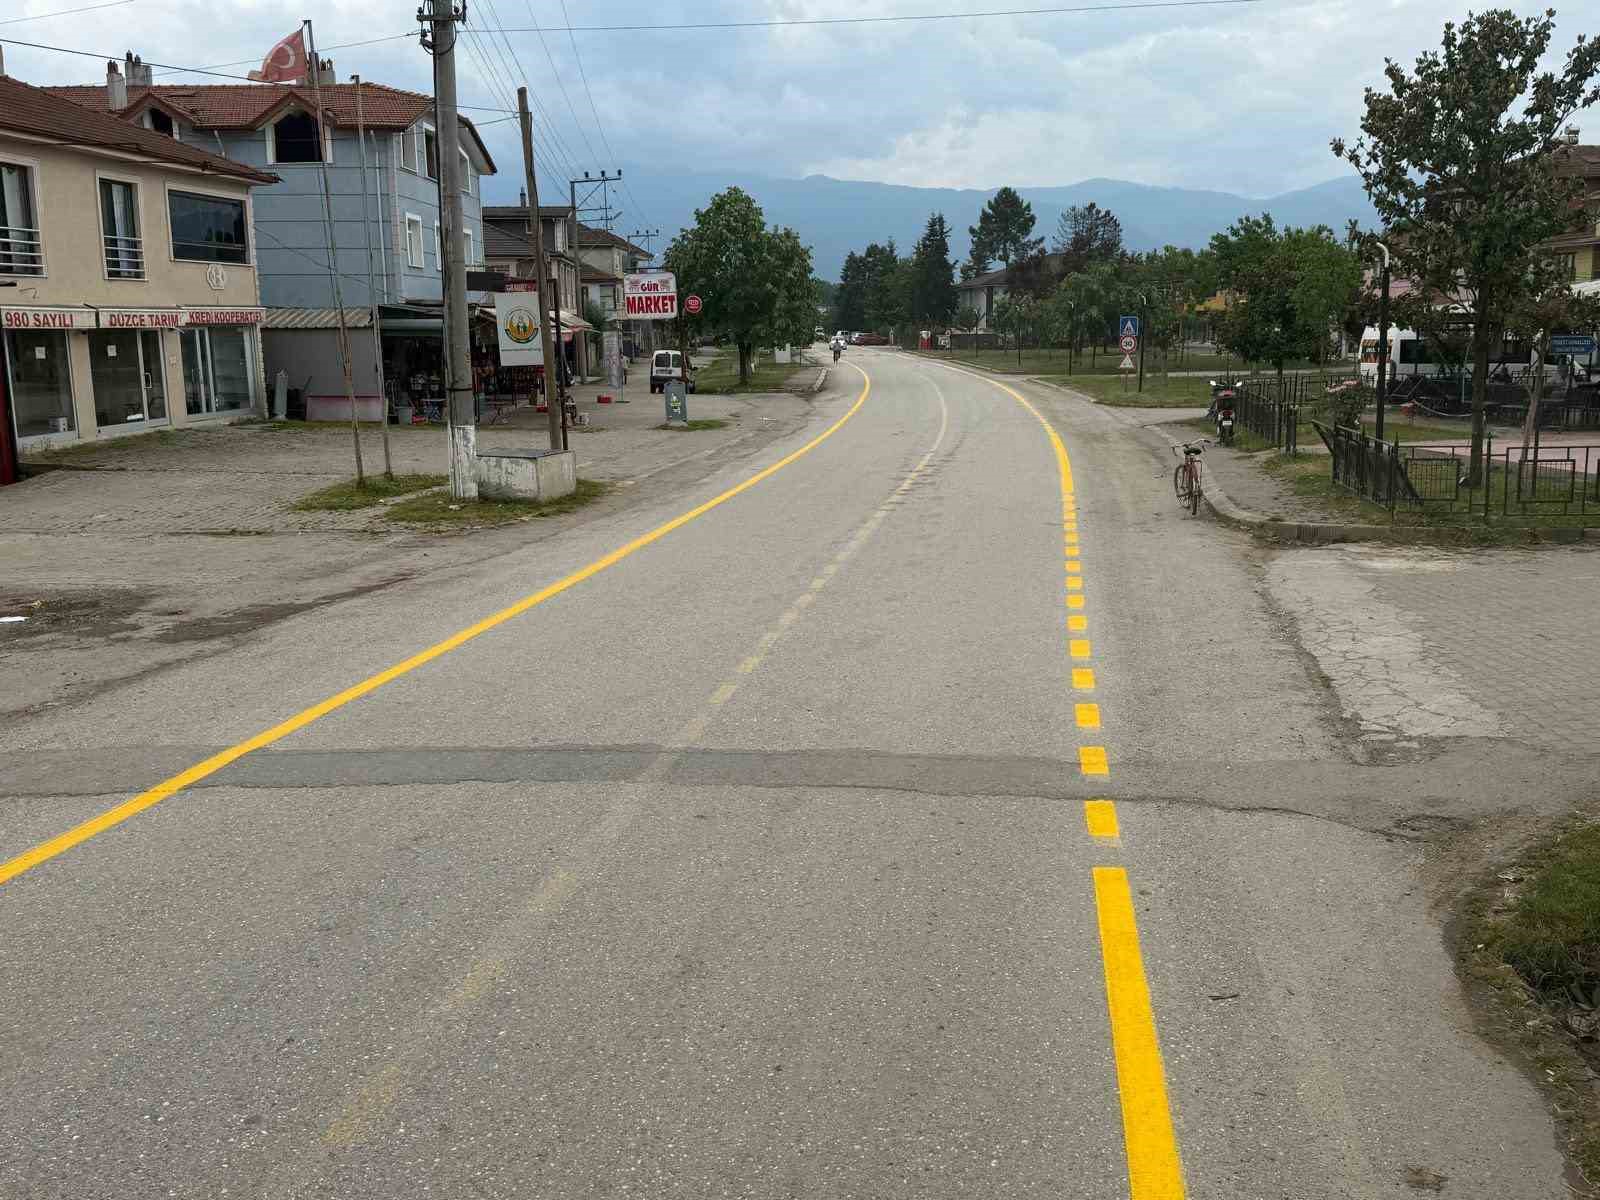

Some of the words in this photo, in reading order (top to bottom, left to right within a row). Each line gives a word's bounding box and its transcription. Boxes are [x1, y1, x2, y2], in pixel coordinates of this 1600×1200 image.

[626, 295, 676, 314] MARKET
[5, 311, 29, 327] 980
[33, 312, 74, 328] SAYILI
